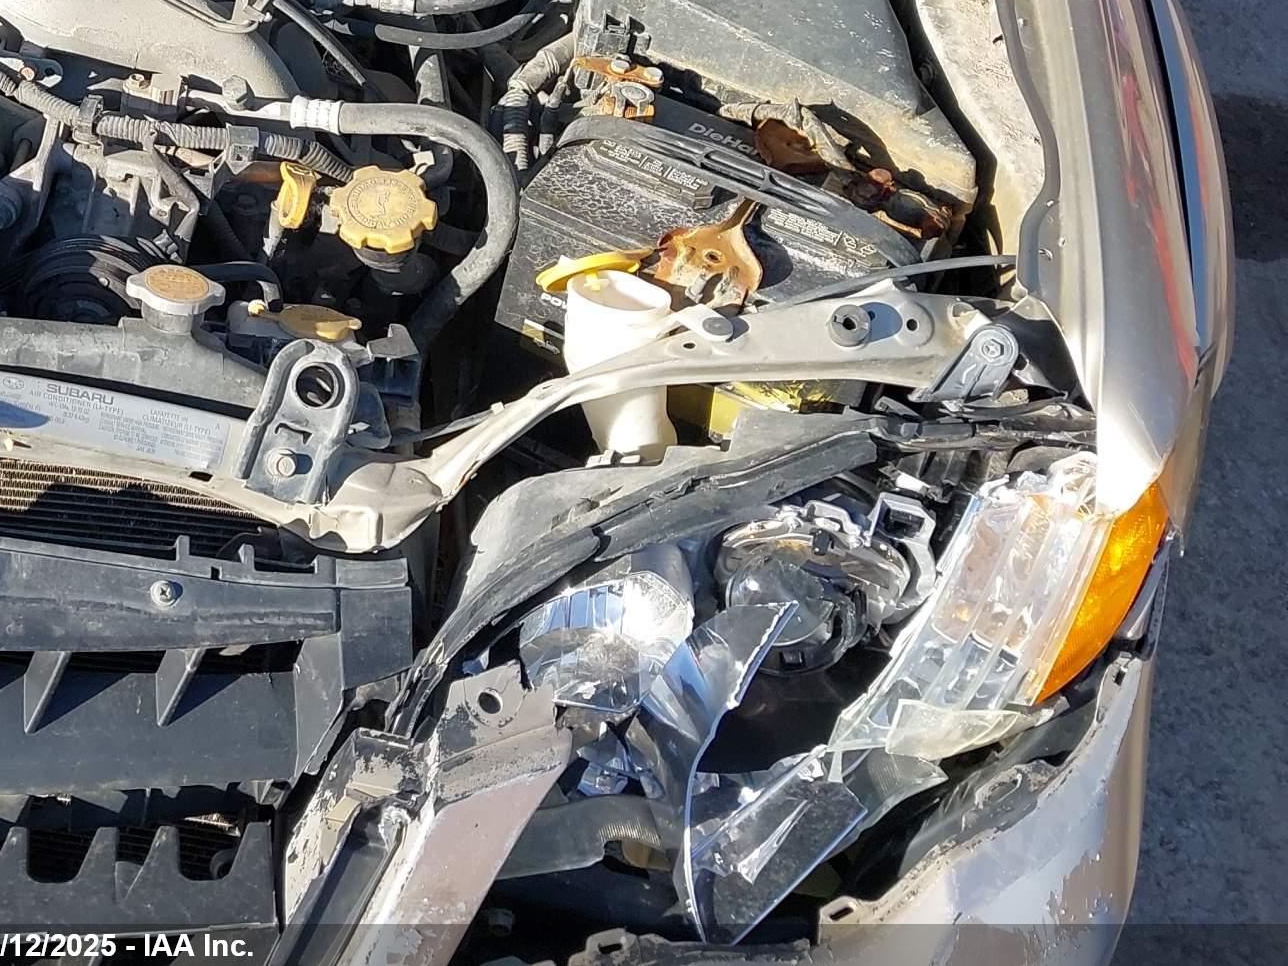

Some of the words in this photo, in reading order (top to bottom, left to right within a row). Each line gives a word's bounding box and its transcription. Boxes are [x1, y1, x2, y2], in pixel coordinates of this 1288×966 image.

[29, 390, 41, 398] AIR
[43, 393, 91, 408] CONDITIONER
[46, 383, 114, 405] SUBARU
